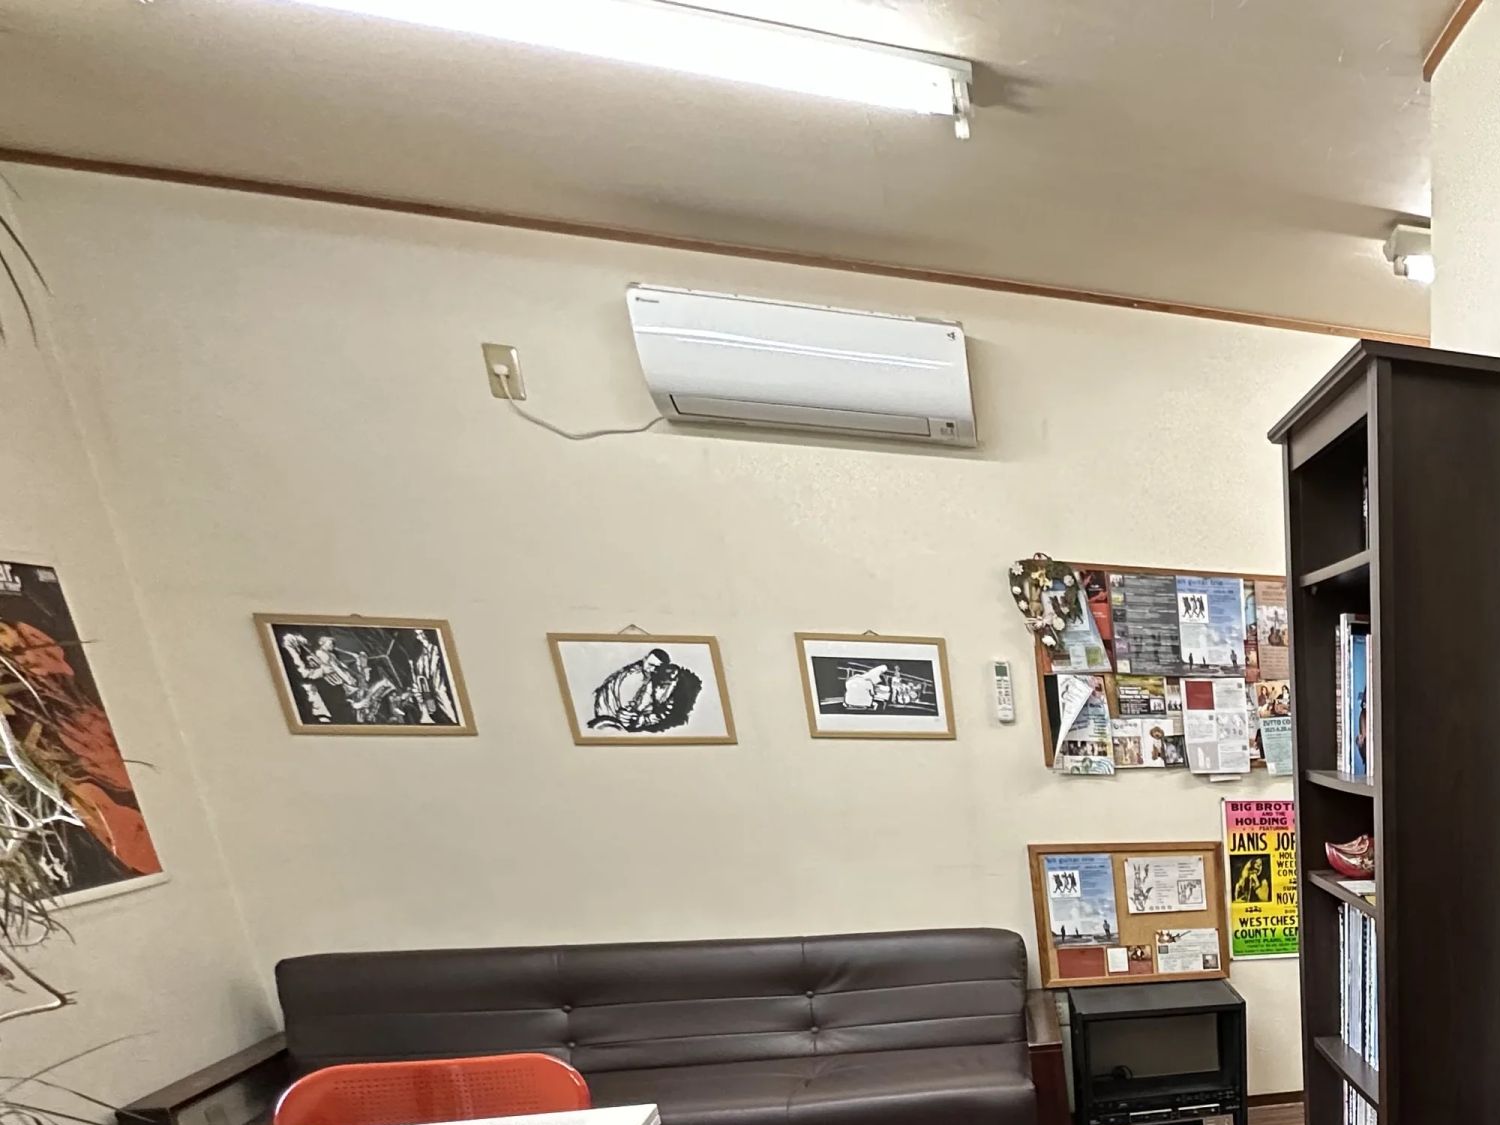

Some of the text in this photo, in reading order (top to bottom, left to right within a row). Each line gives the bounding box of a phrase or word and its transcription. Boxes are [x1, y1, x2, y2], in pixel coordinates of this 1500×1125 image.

[1231, 803, 1251, 811] BIG
[1235, 817, 1287, 826] HOLDING
[1230, 832, 1268, 852] JANIS
[1234, 928, 1276, 939] COUNTY
